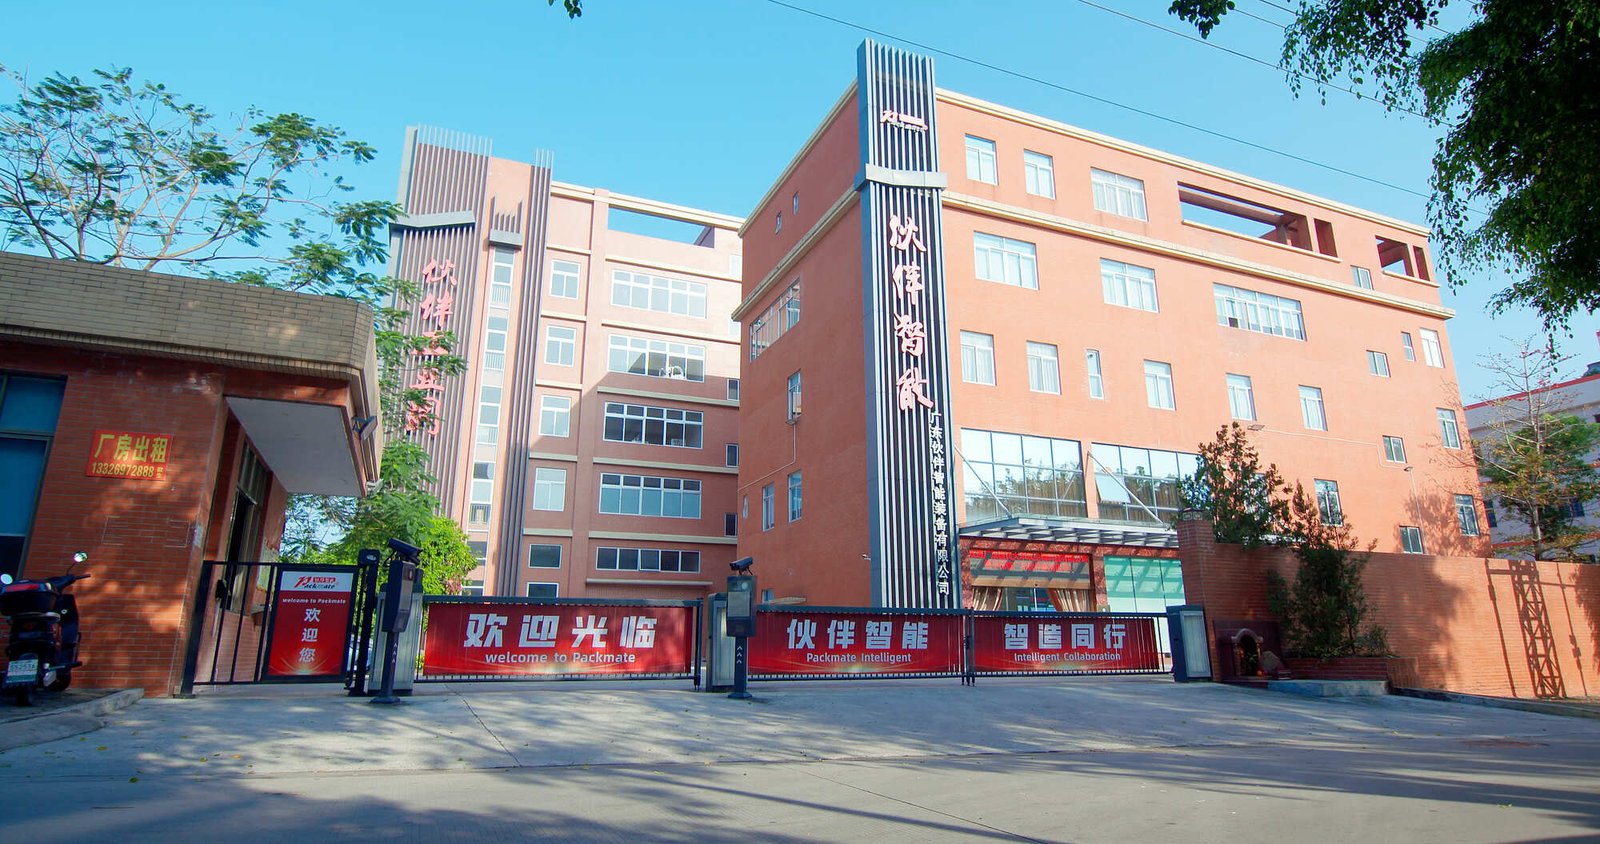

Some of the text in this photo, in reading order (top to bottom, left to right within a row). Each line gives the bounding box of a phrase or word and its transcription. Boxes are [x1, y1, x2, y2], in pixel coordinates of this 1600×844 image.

[888, 214, 935, 410] 伙伴智能
[94, 434, 169, 463] 厂房出租
[92, 462, 155, 478] 13326972888
[930, 412, 949, 595] 广东伙伴智能装备有限公司
[299, 607, 321, 663] 欢迎您
[463, 613, 657, 648] 欢迎光临
[787, 618, 928, 649] 伙伴智能
[1004, 623, 1126, 650] 智造同行
[485, 652, 636, 663] welcome to Packmate
[807, 652, 912, 664] Packmate Intelligent
[1014, 652, 1121, 664] Intelligent Collaboration
